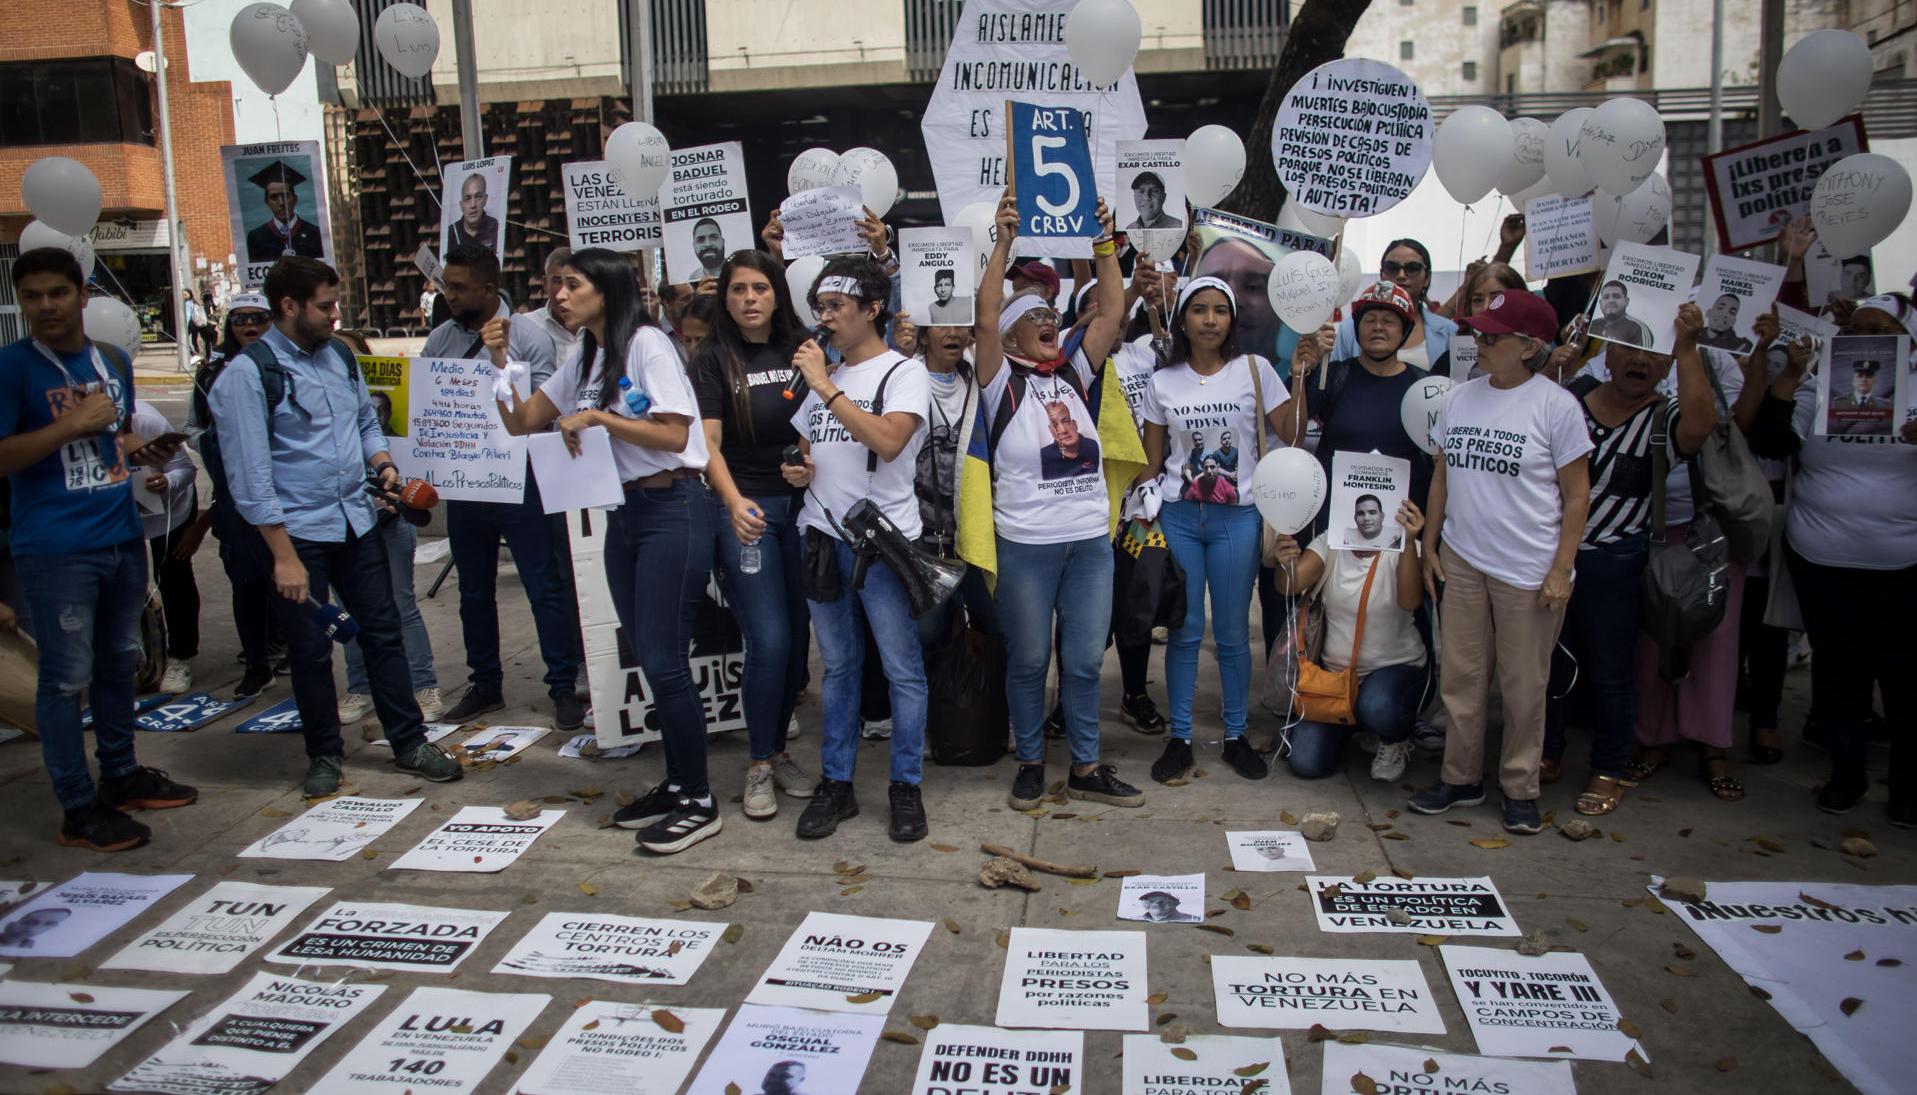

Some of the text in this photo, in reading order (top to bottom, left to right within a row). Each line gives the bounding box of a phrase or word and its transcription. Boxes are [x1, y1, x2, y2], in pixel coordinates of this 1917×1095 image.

[977, 13, 1066, 42] AISLAMIE
[1291, 95, 1348, 114] MUERTES
[971, 109, 991, 138] ES
[1032, 109, 1073, 131] ART.
[242, 143, 300, 156] JUAN FREITES
[1281, 143, 1333, 160] PRESOS
[1333, 134, 1347, 149] DE
[1349, 137, 1389, 153] CASOS
[1394, 142, 1412, 156] DE
[1826, 138, 1843, 152] a
[672, 149, 724, 167] JOSNAR
[462, 161, 476, 171] LUIS
[1279, 157, 1415, 188] PORQUE NO SE LIBERAN
[570, 173, 602, 187] LAS
[673, 164, 728, 183] BADUEL
[1032, 135, 1081, 217] 5
[1285, 170, 1356, 191] LOS PRESOS
[673, 178, 728, 194] está siendo
[673, 187, 733, 206] torturado
[577, 197, 619, 212] ESTÁN
[671, 202, 740, 220] EN EL RODEO
[577, 211, 650, 228] INOCENTES
[1030, 216, 1084, 235] CRBV
[578, 226, 662, 245] TERRORIS
[1537, 232, 1586, 247] HERMANOS
[1538, 240, 1588, 254] ZAMBRANO
[1632, 268, 1666, 281] DIXON
[1719, 285, 1754, 297] TORRES
[1721, 278, 1754, 290] MAIKEL
[379, 361, 402, 376] DÍAS
[430, 361, 465, 375] Medio
[769, 370, 778, 383] NO
[455, 387, 476, 397] días
[453, 400, 482, 410] horas
[1172, 402, 1241, 416] NO SOMOS
[455, 410, 487, 420] Minutos
[452, 420, 499, 431] Segundos
[1185, 417, 1228, 429] PDVSA
[1446, 426, 1527, 445] LIBEREN A TODOS
[413, 450, 446, 459] Contra
[1467, 439, 1524, 460] PRESOS
[1038, 480, 1075, 490] PERIODISTA
[1343, 481, 1396, 492] MONTESINO
[1347, 474, 1393, 485] FRANKLIN
[1075, 485, 1093, 493] DELITO
[474, 825, 539, 833] APOYO
[445, 846, 519, 854] TORTURA
[1360, 882, 1491, 892] TORTURA
[1360, 895, 1483, 906] UN POLÍTICA
[206, 900, 288, 917] TUN
[1335, 903, 1478, 915] DE EN
[313, 919, 479, 938] FORZADA
[562, 921, 712, 939] CIERREN LOS
[138, 939, 249, 952] POLÍTICA
[304, 938, 459, 954] ES UN CRIMEN DE
[555, 931, 664, 947] CENTROS
[804, 934, 909, 953] NÃO OS
[291, 945, 453, 962] LESA HUMANIDAD
[565, 942, 673, 958] TORTURA
[850, 950, 904, 959] MORRER
[1027, 951, 1125, 960] LIBERTAD
[1041, 960, 1080, 968] PARA
[1026, 968, 1123, 978] PERIODISTAS
[1264, 971, 1378, 985] NO MÁS
[1528, 971, 1591, 983] TOCORÓN
[266, 981, 364, 998] NICOLÁS
[1021, 978, 1130, 990] PRESOS
[1025, 991, 1125, 1000] por razones
[1228, 984, 1419, 1000] TORTURA EN
[1464, 981, 1604, 1003] Y YARE III
[252, 992, 353, 1008] MADURO
[1239, 996, 1418, 1014] VENEZUELA
[1518, 1000, 1589, 1010] convertido
[1476, 1007, 1615, 1022] CAMPOS DE
[238, 1020, 315, 1033] CUALQUIERA
[399, 1014, 505, 1035] LULA
[1478, 1017, 1622, 1031] CONCENTRACIÓN
[207, 1035, 266, 1047] DISTINTO
[255, 1029, 300, 1040] PIENSE
[414, 1033, 494, 1043] VENEZUELA
[580, 1031, 686, 1045] CONDIÇÕES DOS
[567, 1037, 688, 1052] PRESOS POLÍTICOS
[606, 1048, 651, 1058] RODEO
[934, 1044, 1073, 1064] DEFENDER DDHH
[388, 1058, 446, 1075] 140
[349, 1073, 465, 1088] TRABAJADORES
[929, 1060, 1071, 1088] NO ES UN
[1390, 1069, 1434, 1086] NO
[1444, 1077, 1510, 1095] MÁS
